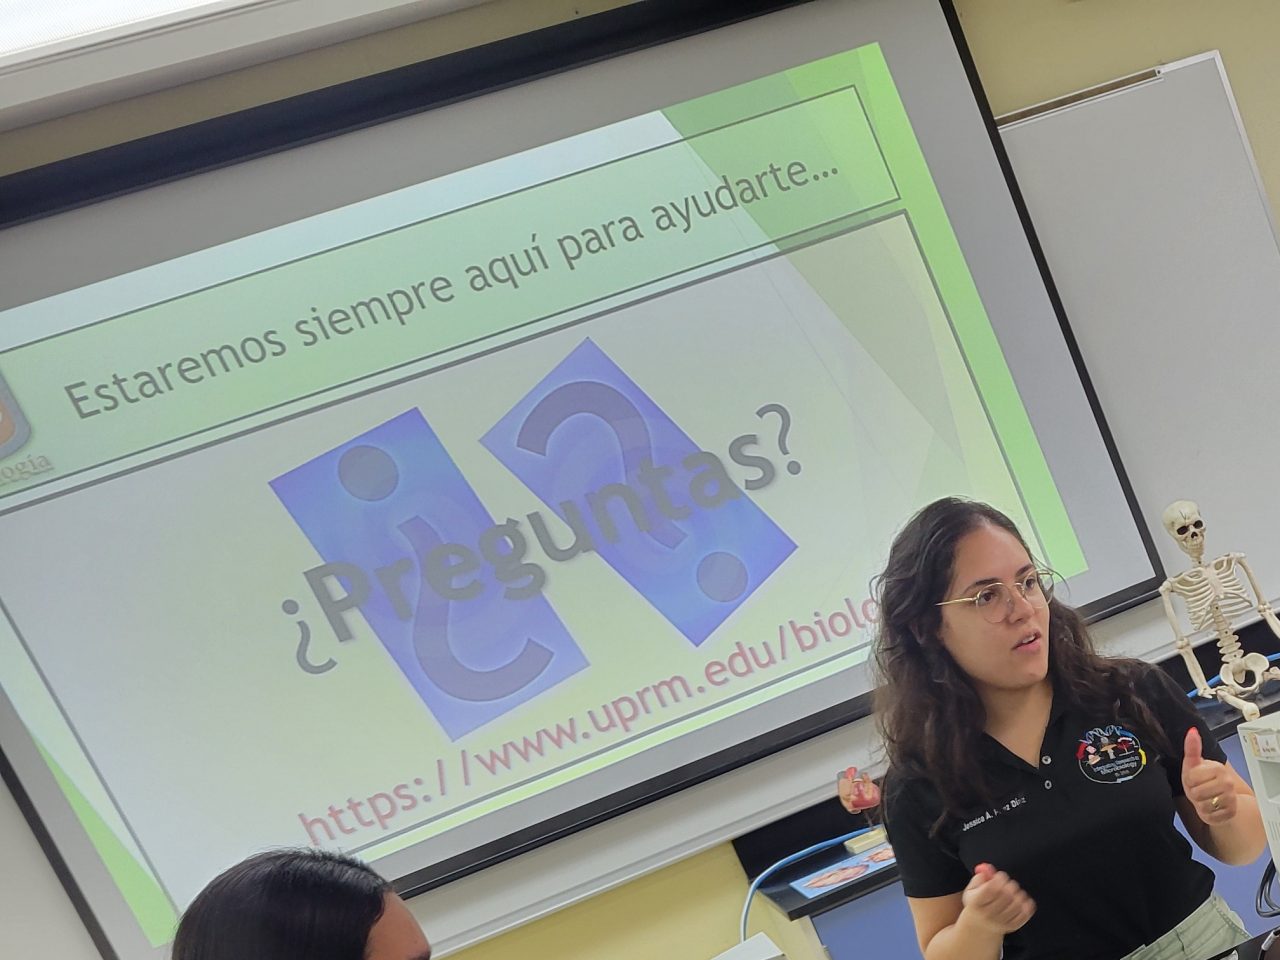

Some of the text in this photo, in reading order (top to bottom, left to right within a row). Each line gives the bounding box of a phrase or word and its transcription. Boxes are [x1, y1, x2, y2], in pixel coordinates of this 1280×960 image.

[64, 159, 839, 420] Estaremos siempre aquí para ayudarte...
[281, 403, 802, 675] ¿Preguntas?
